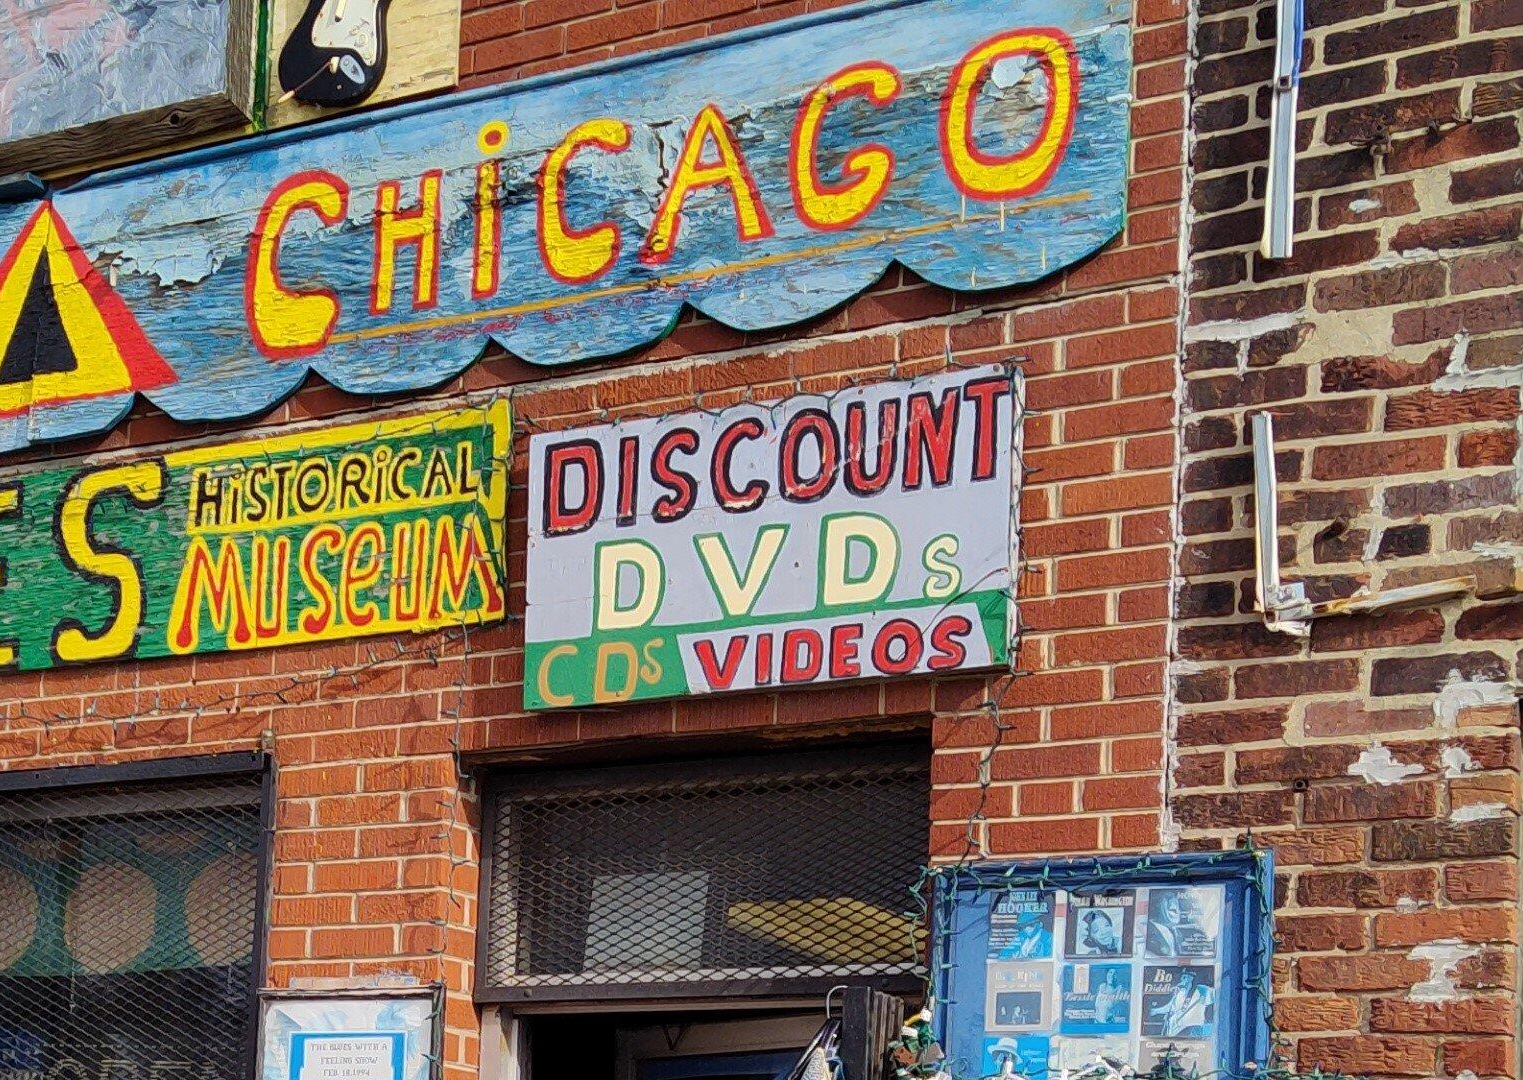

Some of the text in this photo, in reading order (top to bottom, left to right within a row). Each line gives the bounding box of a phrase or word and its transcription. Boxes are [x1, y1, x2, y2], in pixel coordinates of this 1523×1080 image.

[543, 378, 1014, 536] DISCOUNT
[693, 615, 973, 692] VIDEOS
[998, 902, 1049, 914] HOOKER
[1153, 968, 1173, 982] Bo
[329, 1043, 352, 1051] BLUES
[355, 1043, 379, 1051] WITH
[320, 1056, 379, 1065] FEELING SHOW
